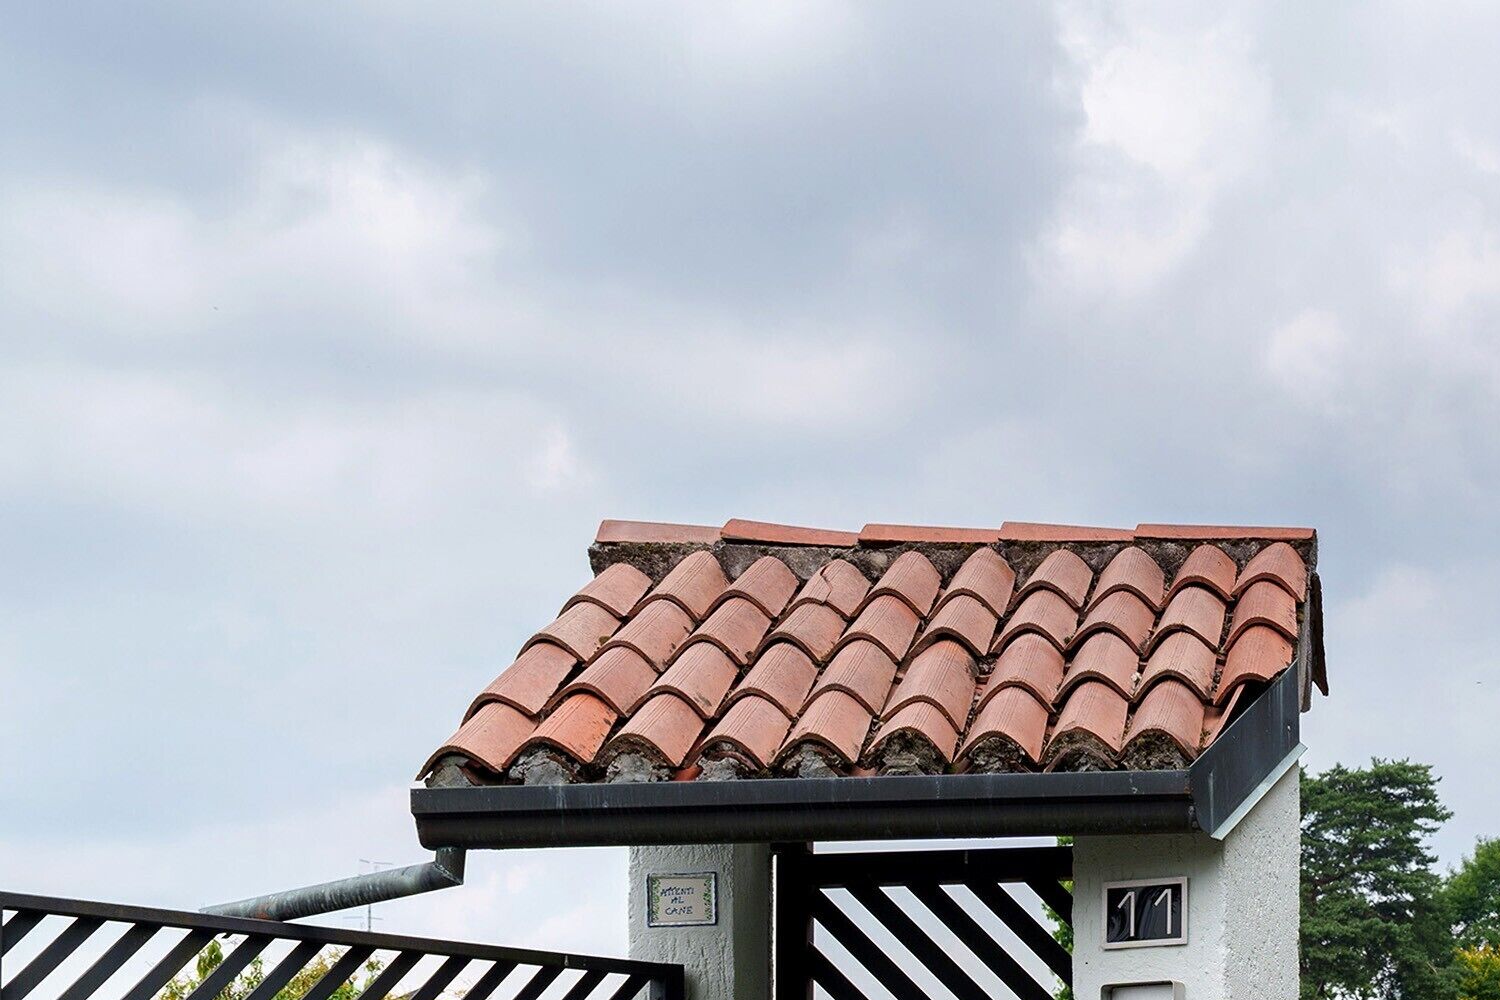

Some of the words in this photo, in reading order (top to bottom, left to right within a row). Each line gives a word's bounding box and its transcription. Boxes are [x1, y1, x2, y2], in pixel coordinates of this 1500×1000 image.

[660, 887, 694, 896] ATTENTI
[665, 906, 693, 915] CANE
[1117, 888, 1172, 937] 11
